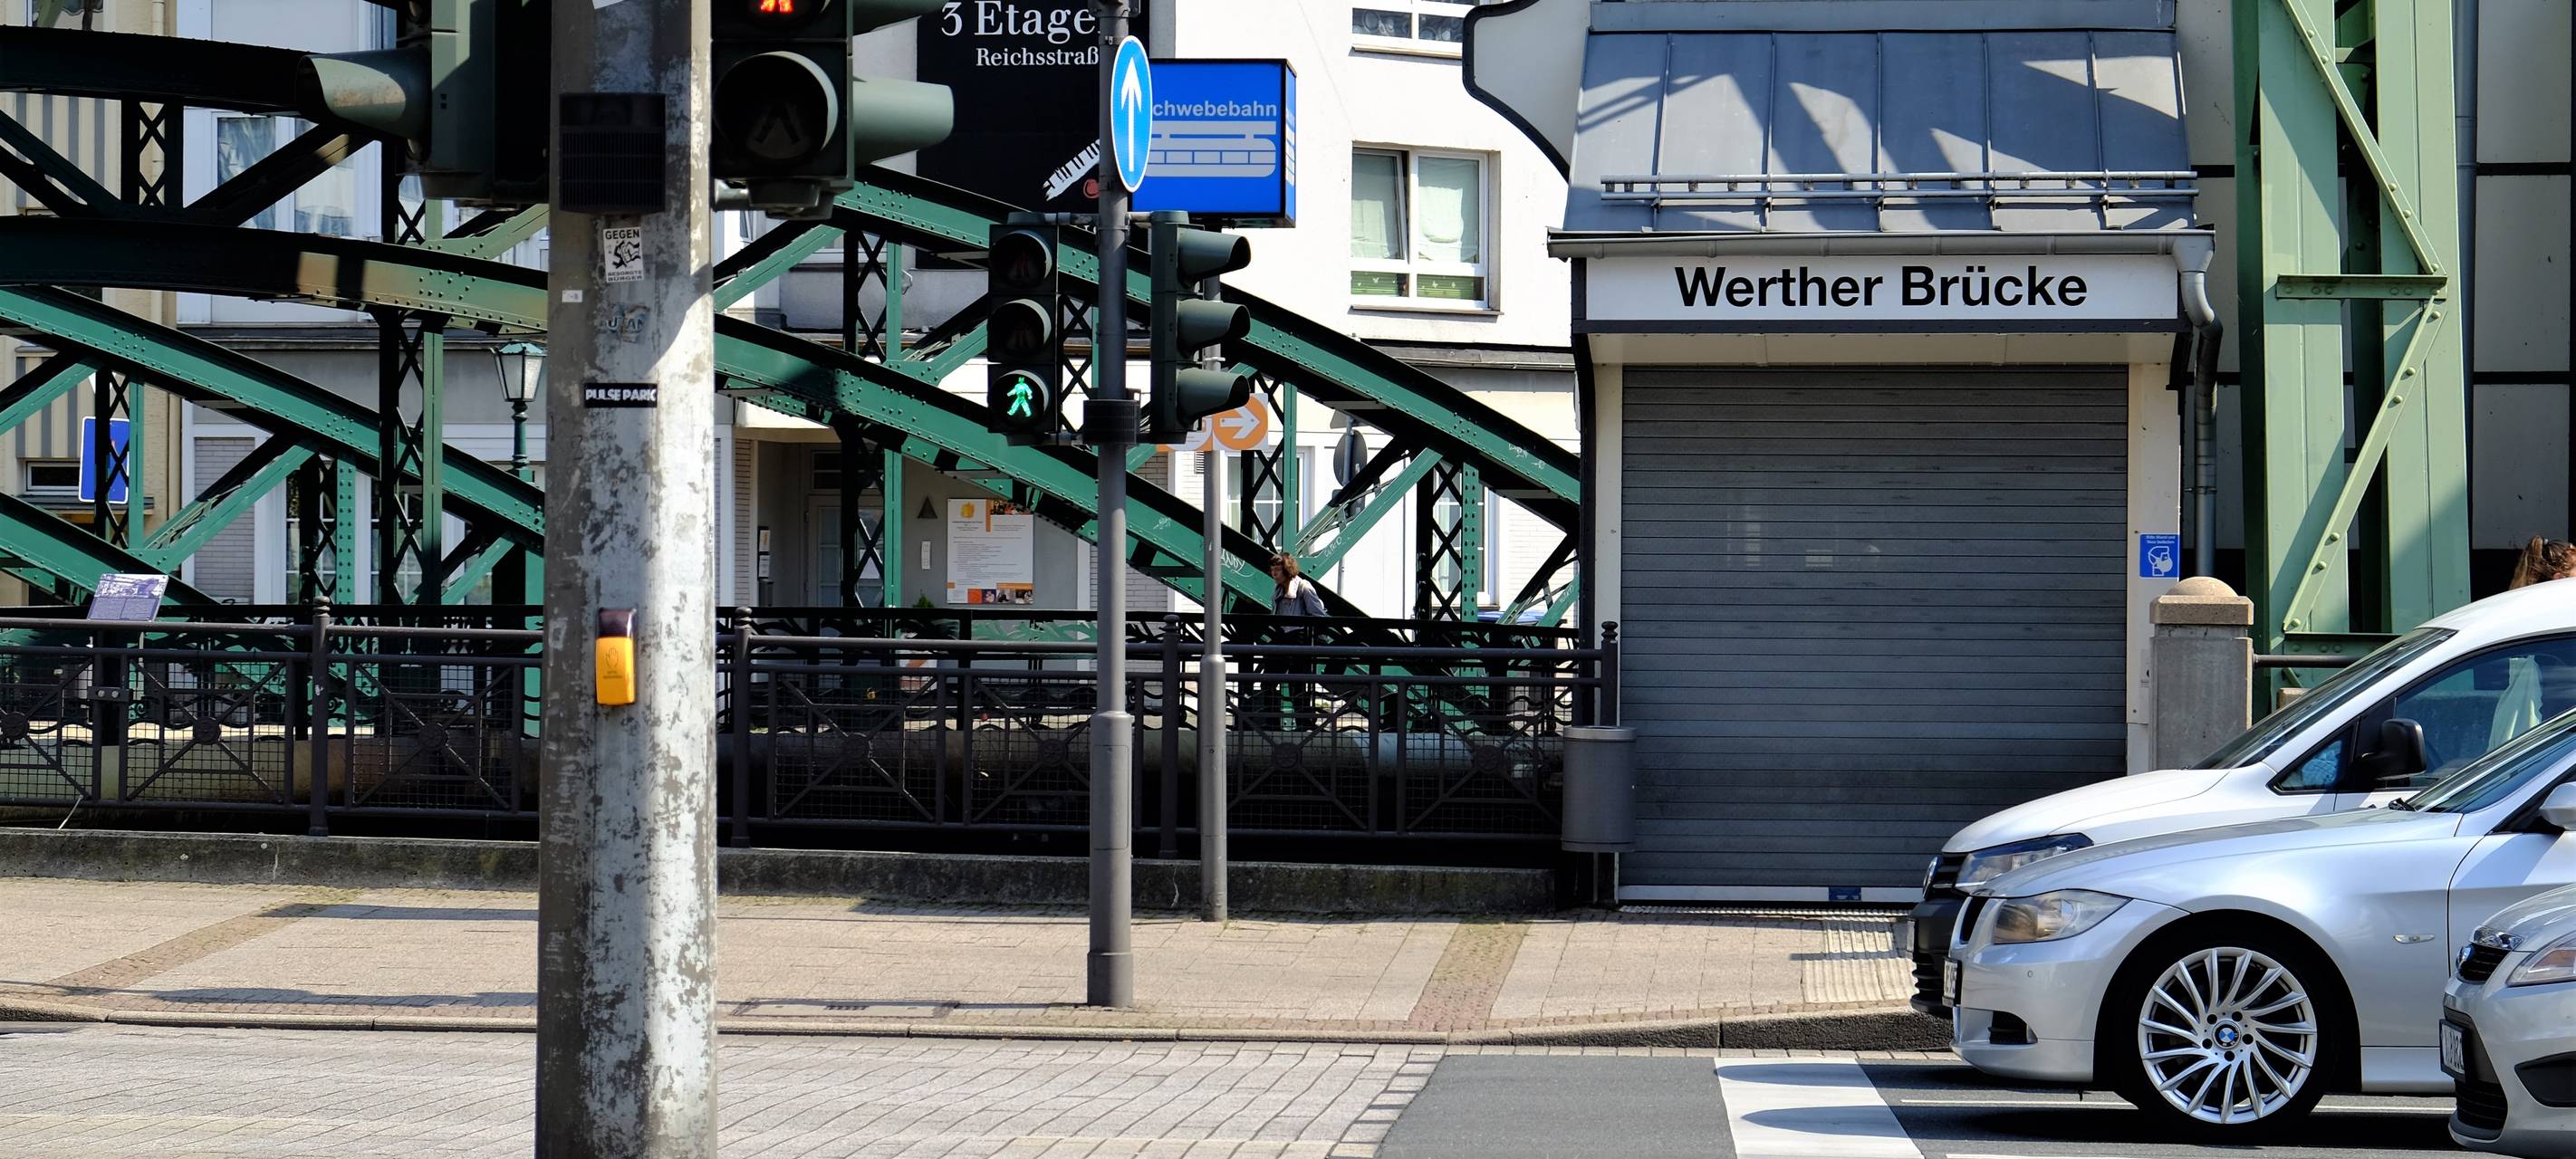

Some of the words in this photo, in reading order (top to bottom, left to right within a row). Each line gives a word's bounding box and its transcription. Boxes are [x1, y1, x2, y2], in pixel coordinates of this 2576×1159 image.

[941, 2, 963, 36] 3
[974, 1, 1101, 44] Etage
[976, 45, 1100, 67] Reichsstraß
[1152, 101, 1277, 117] chwebebahn
[605, 229, 639, 240] GEGEN
[1674, 265, 1884, 308] Werther
[1901, 265, 2088, 308] Brücke
[585, 388, 621, 401] PULSE
[622, 388, 657, 402] PARK
